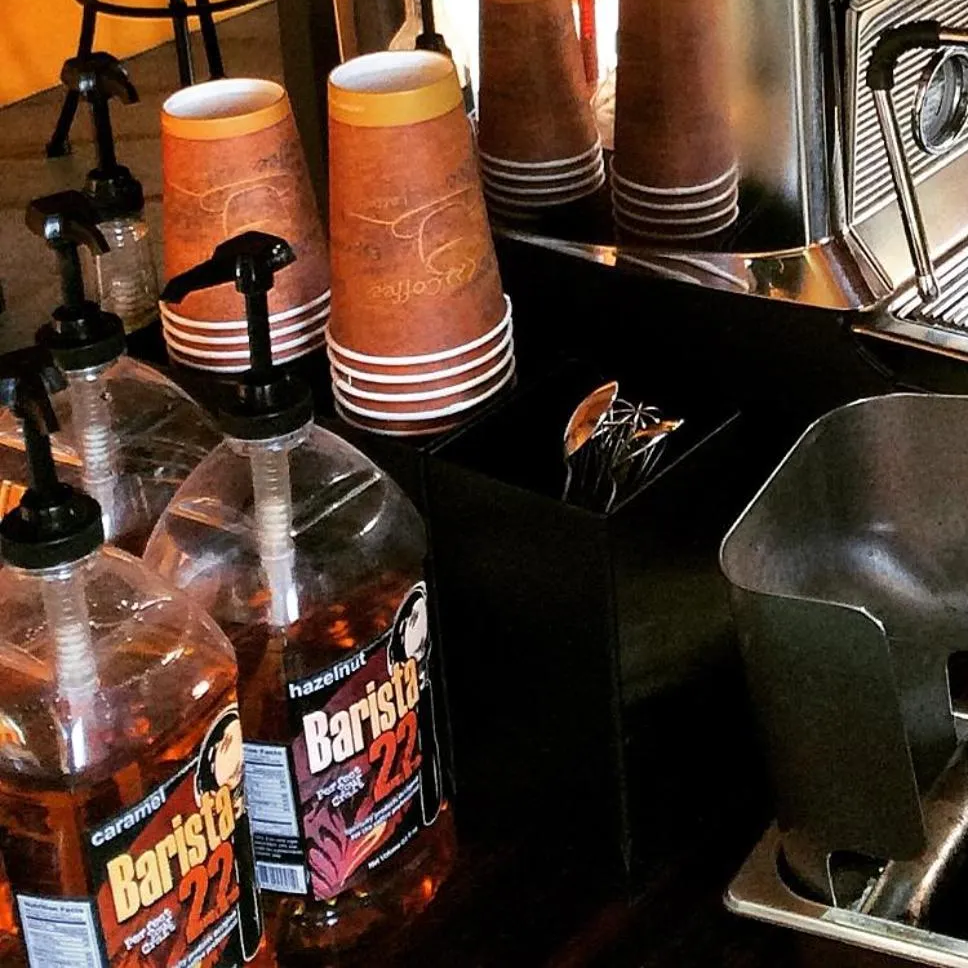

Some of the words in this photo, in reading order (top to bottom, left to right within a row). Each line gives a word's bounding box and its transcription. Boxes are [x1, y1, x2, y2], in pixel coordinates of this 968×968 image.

[288, 651, 368, 699] hazelnut
[302, 657, 420, 774] Barista
[368, 710, 422, 803] 22
[91, 788, 167, 846] caramel
[106, 785, 235, 923] Barista
[179, 841, 240, 944] 22
